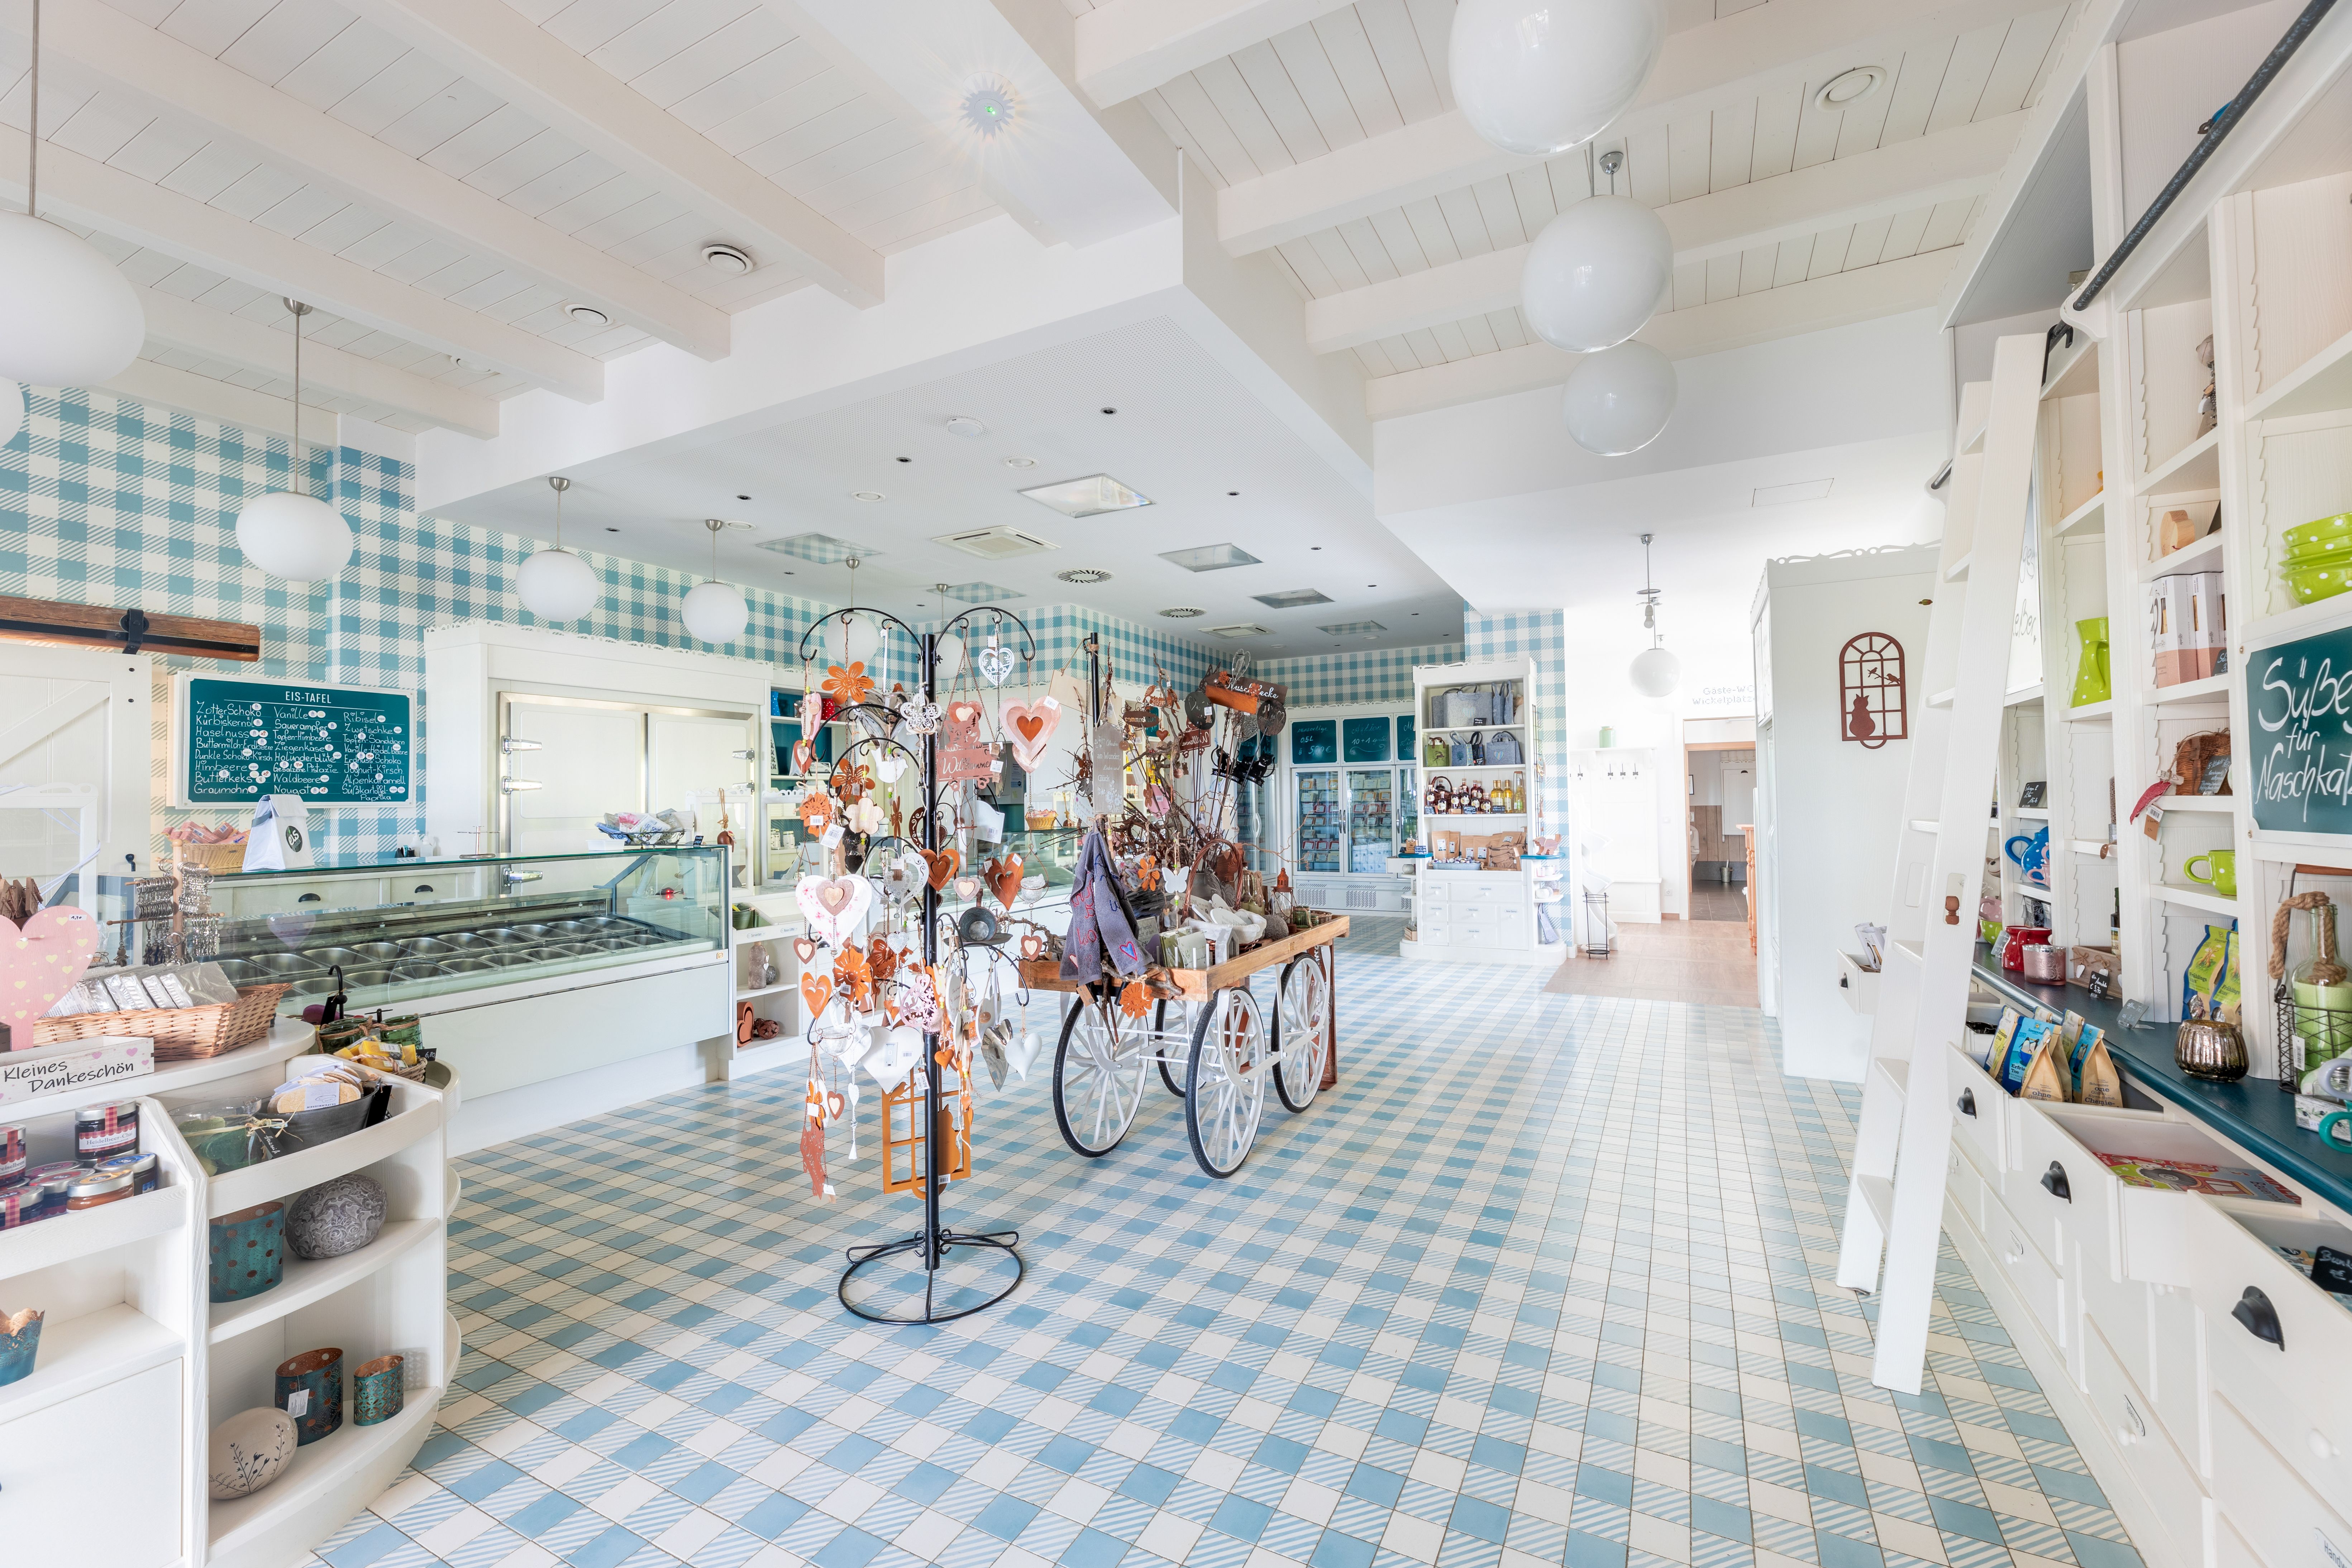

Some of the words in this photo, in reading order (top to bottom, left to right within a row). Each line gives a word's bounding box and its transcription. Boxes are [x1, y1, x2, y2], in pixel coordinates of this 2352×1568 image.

[1703, 685, 1755, 695] Gäste-WC
[2258, 657, 2352, 734] Süße
[286, 691, 331, 703] EIS-TAFEL
[1692, 695, 1755, 705] Wickelplätz
[274, 706, 308, 719] Vanille
[344, 711, 378, 723] Ribisel
[196, 714, 254, 727] Kürbiskernöl
[275, 719, 327, 733] Sauerampfer
[196, 726, 249, 738] Haselnuss
[345, 723, 393, 734] Zwetschke
[272, 729, 331, 741] Topfen-Himbeere
[2286, 718, 2320, 759] für
[196, 737, 273, 750] Buttermilch-Erdbeere
[274, 741, 325, 754] Ziegenkäse
[344, 743, 408, 755] Vanille-Heidelbeere
[195, 749, 221, 759] Dunkle
[223, 749, 273, 761] Schoko-Kirsch
[275, 751, 336, 763] Holunderblüte
[344, 754, 401, 764] Erdnuss-Schoko
[1104, 752, 1121, 761] Wunder,
[195, 760, 247, 771] Himbeere
[273, 762, 306, 773] Gesalzene
[306, 763, 338, 773] Pistazie
[344, 764, 403, 776] Joghurt-Kirsch
[940, 756, 991, 774] Willkomme
[195, 771, 252, 783] Butterkeks
[273, 773, 321, 783] Waldbeere
[343, 774, 406, 785] Alpenkaramell
[2255, 743, 2352, 822] Naschkat
[194, 783, 248, 794] Graumohn
[274, 784, 311, 796] Nougat
[2222, 984, 2241, 995] Frühlings
[4, 1061, 67, 1082] Kleines
[28, 1063, 134, 1093] Dankeschön
[2085, 1097, 2115, 1105] Chemie-
[87, 1131, 133, 1145] Heidelbeer-Chai
[0, 1160, 25, 1172] reiselbeere
